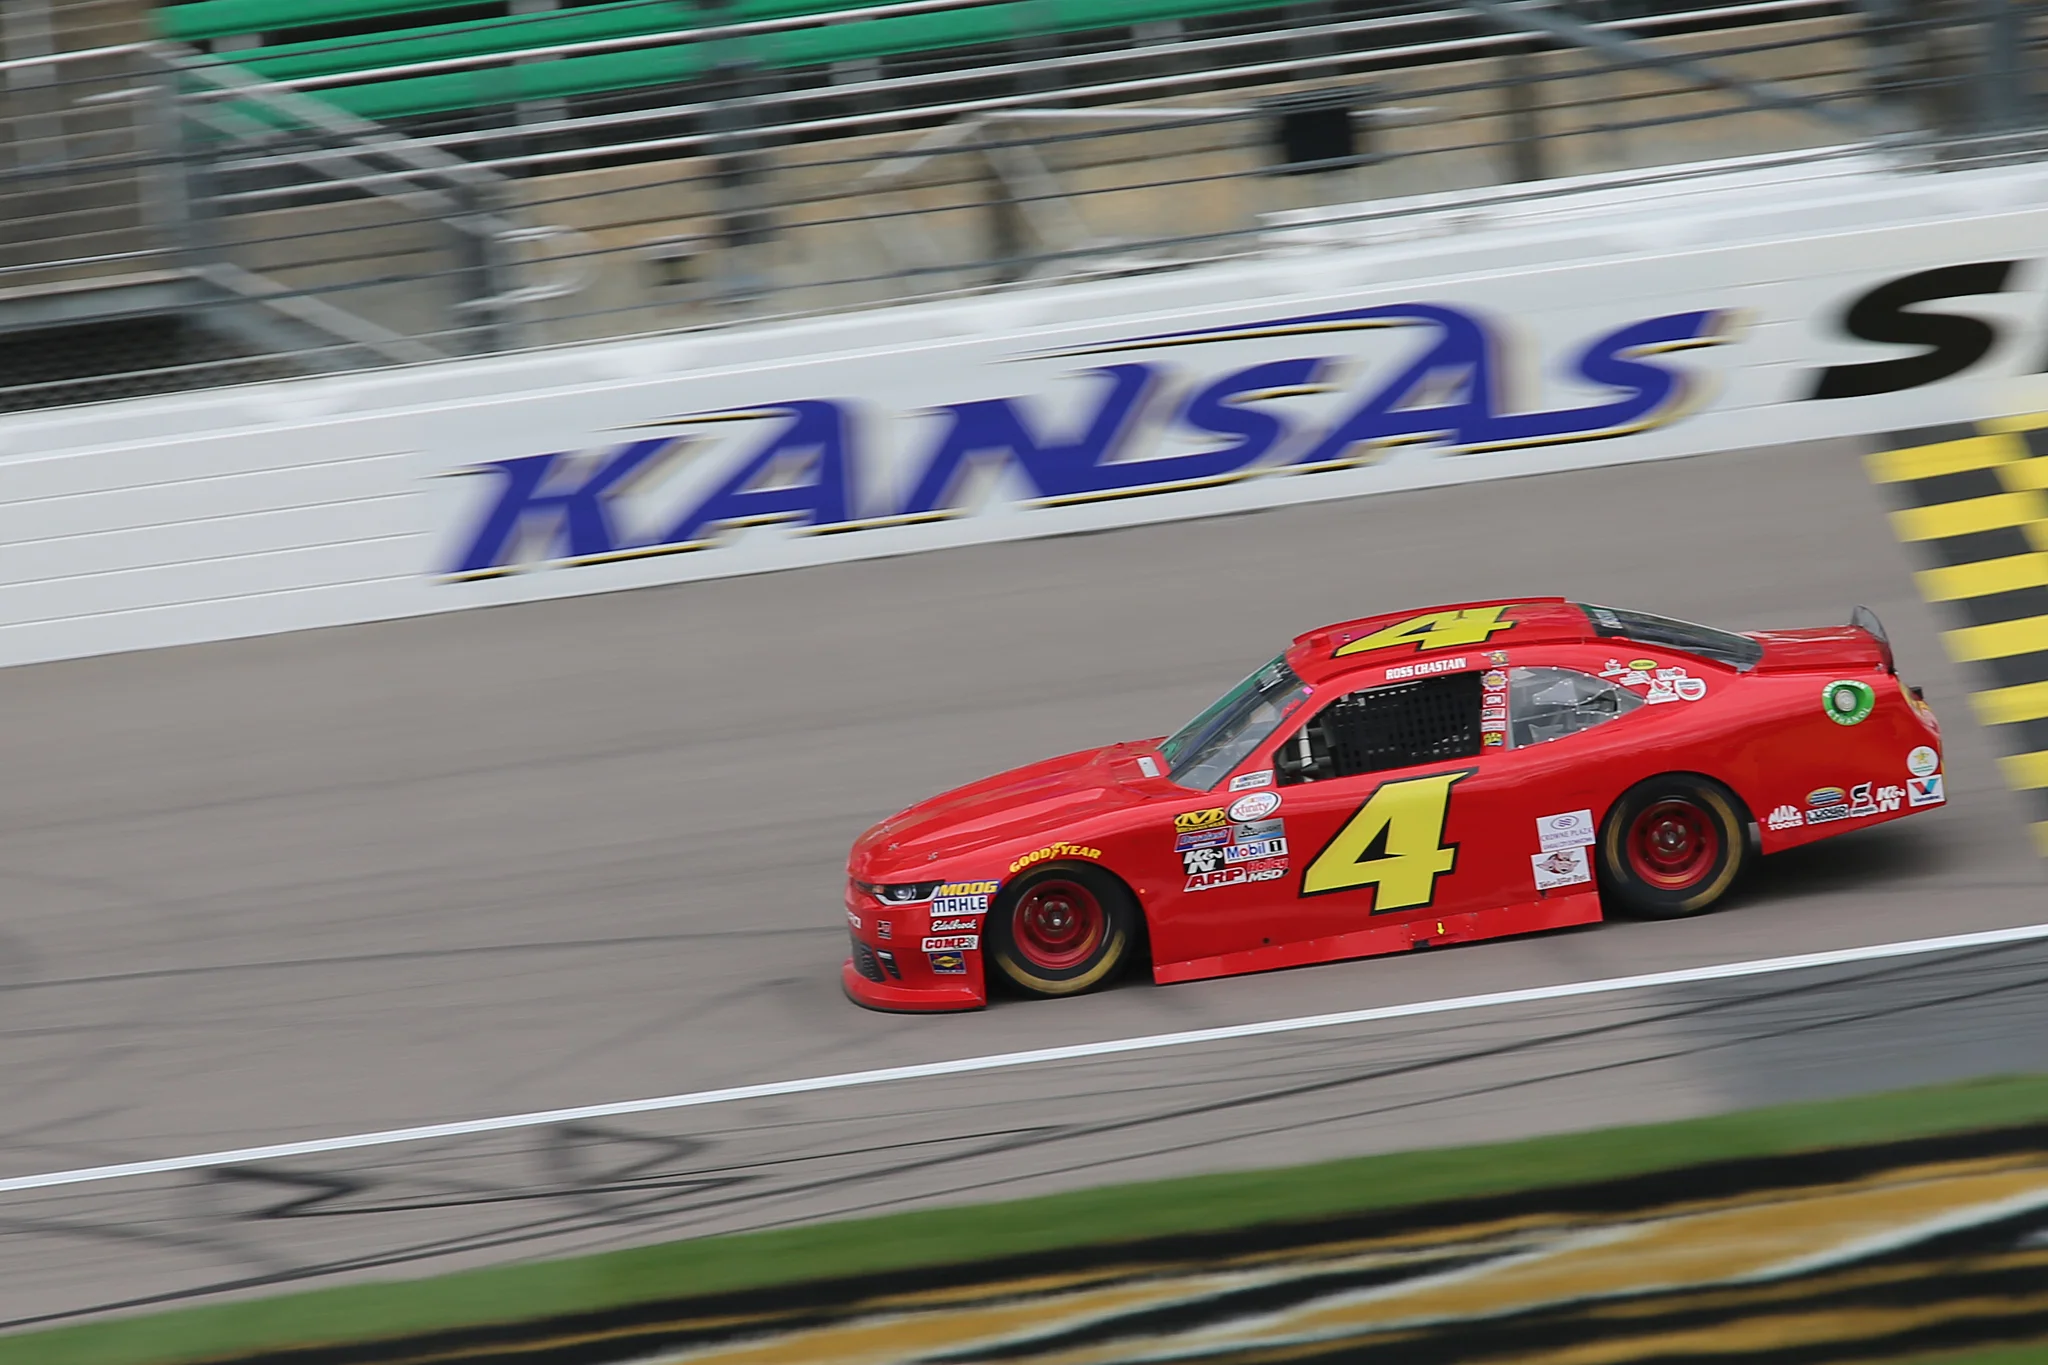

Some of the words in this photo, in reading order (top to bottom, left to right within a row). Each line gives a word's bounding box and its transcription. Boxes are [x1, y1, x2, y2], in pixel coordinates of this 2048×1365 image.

[440, 302, 1730, 582] KANSAS
[1331, 604, 1521, 658] 4
[1385, 665, 1414, 680] ROSS
[1414, 657, 1467, 675] CHASTAIN
[1826, 707, 1872, 725] ETHANOL
[1768, 805, 1803, 824] MAC
[1768, 820, 1804, 830] TOOLS
[1227, 842, 1266, 858] Mobil
[1298, 766, 1479, 916] 4
[1009, 841, 1102, 873] GOODYEAR
[1187, 868, 1243, 887] ARP
[1247, 868, 1284, 882] MSD
[938, 881, 999, 896] MOOG
[931, 897, 987, 912] MAHLE
[931, 919, 978, 932] Edelbrock
